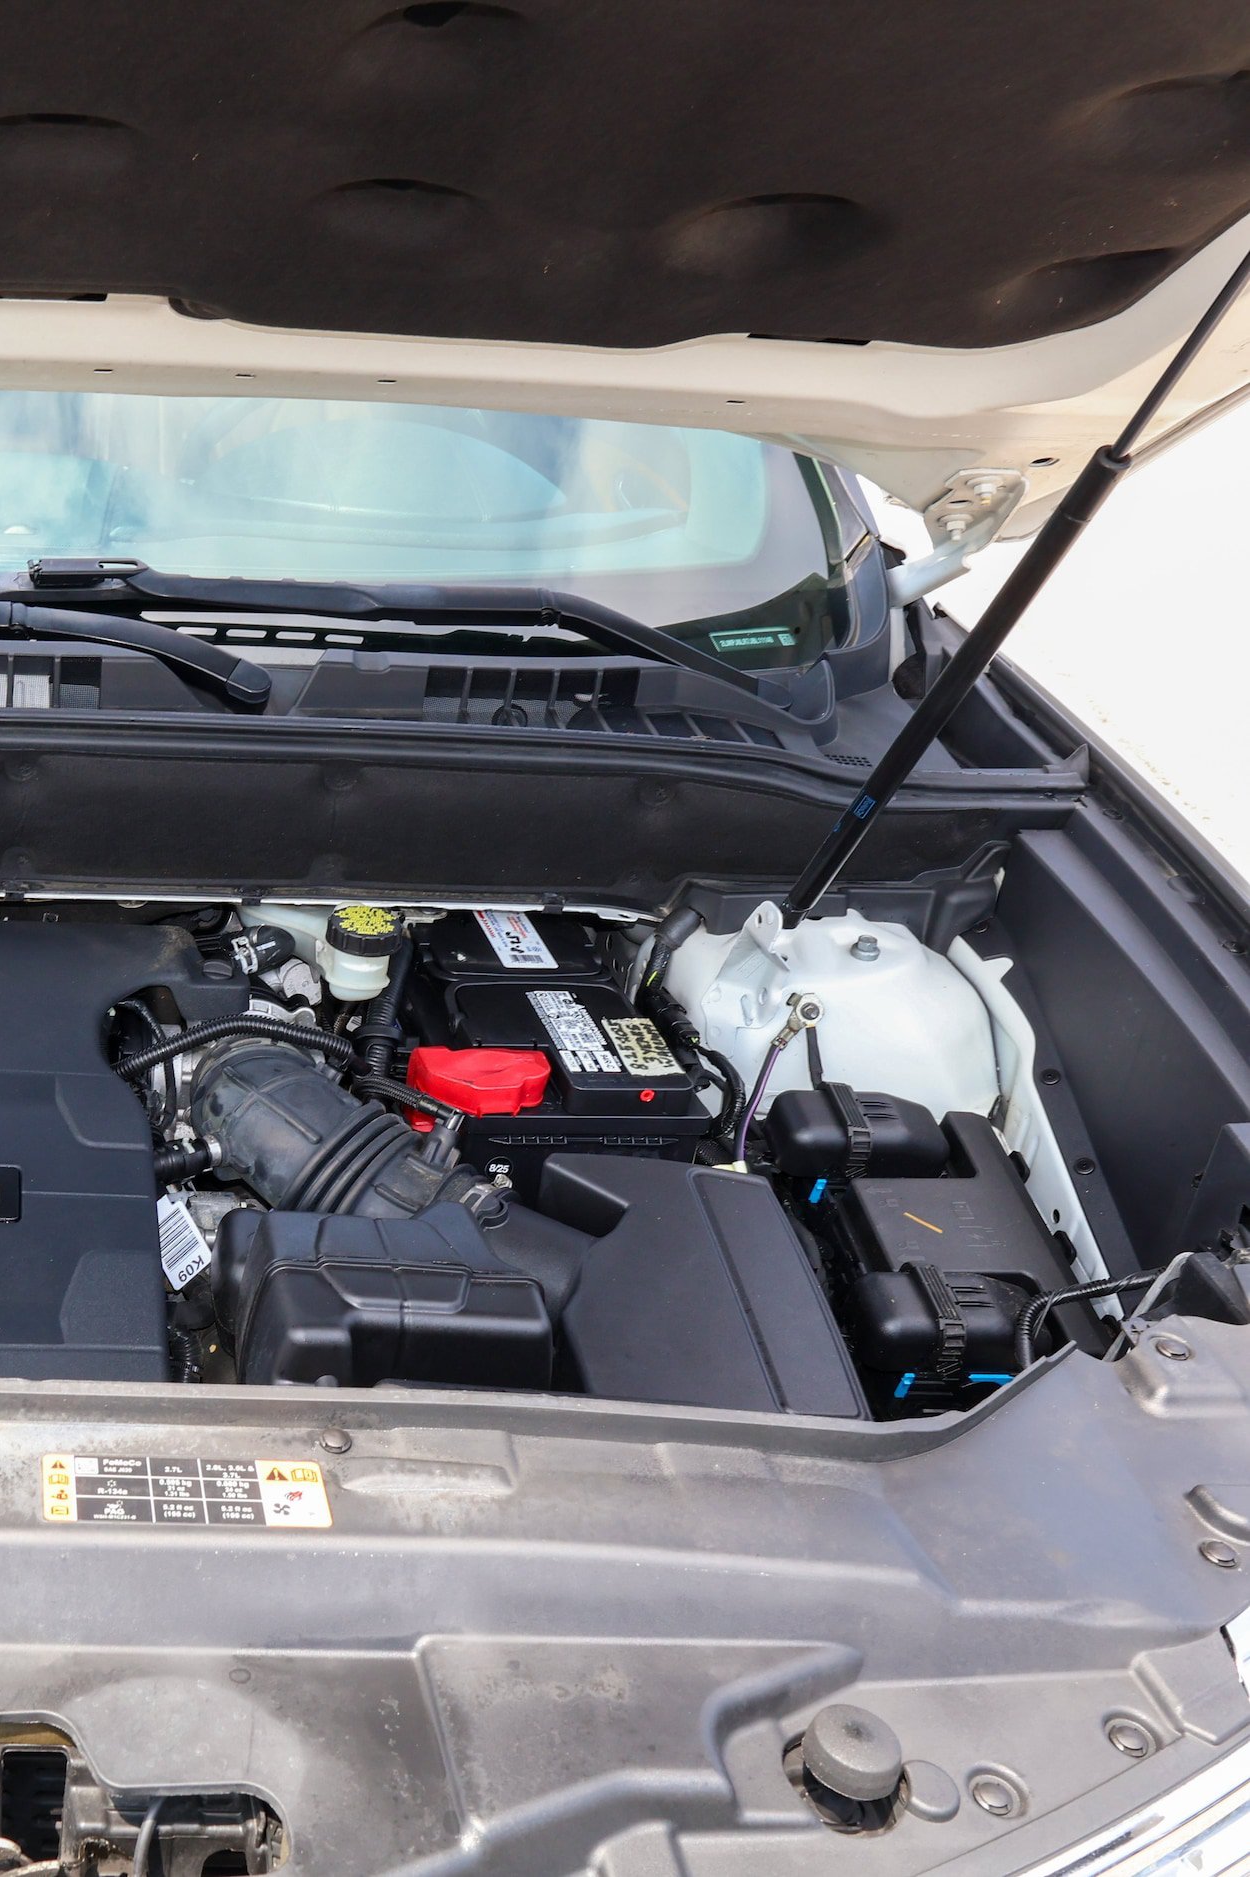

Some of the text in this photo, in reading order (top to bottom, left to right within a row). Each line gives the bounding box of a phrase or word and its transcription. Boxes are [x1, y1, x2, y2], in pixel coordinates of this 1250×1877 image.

[488, 1163, 510, 1174] 8/25
[177, 1255, 205, 1283] K09
[102, 1458, 142, 1467] FoMoCo
[164, 1465, 183, 1473] 2.7L
[97, 1487, 129, 1495] R-134a
